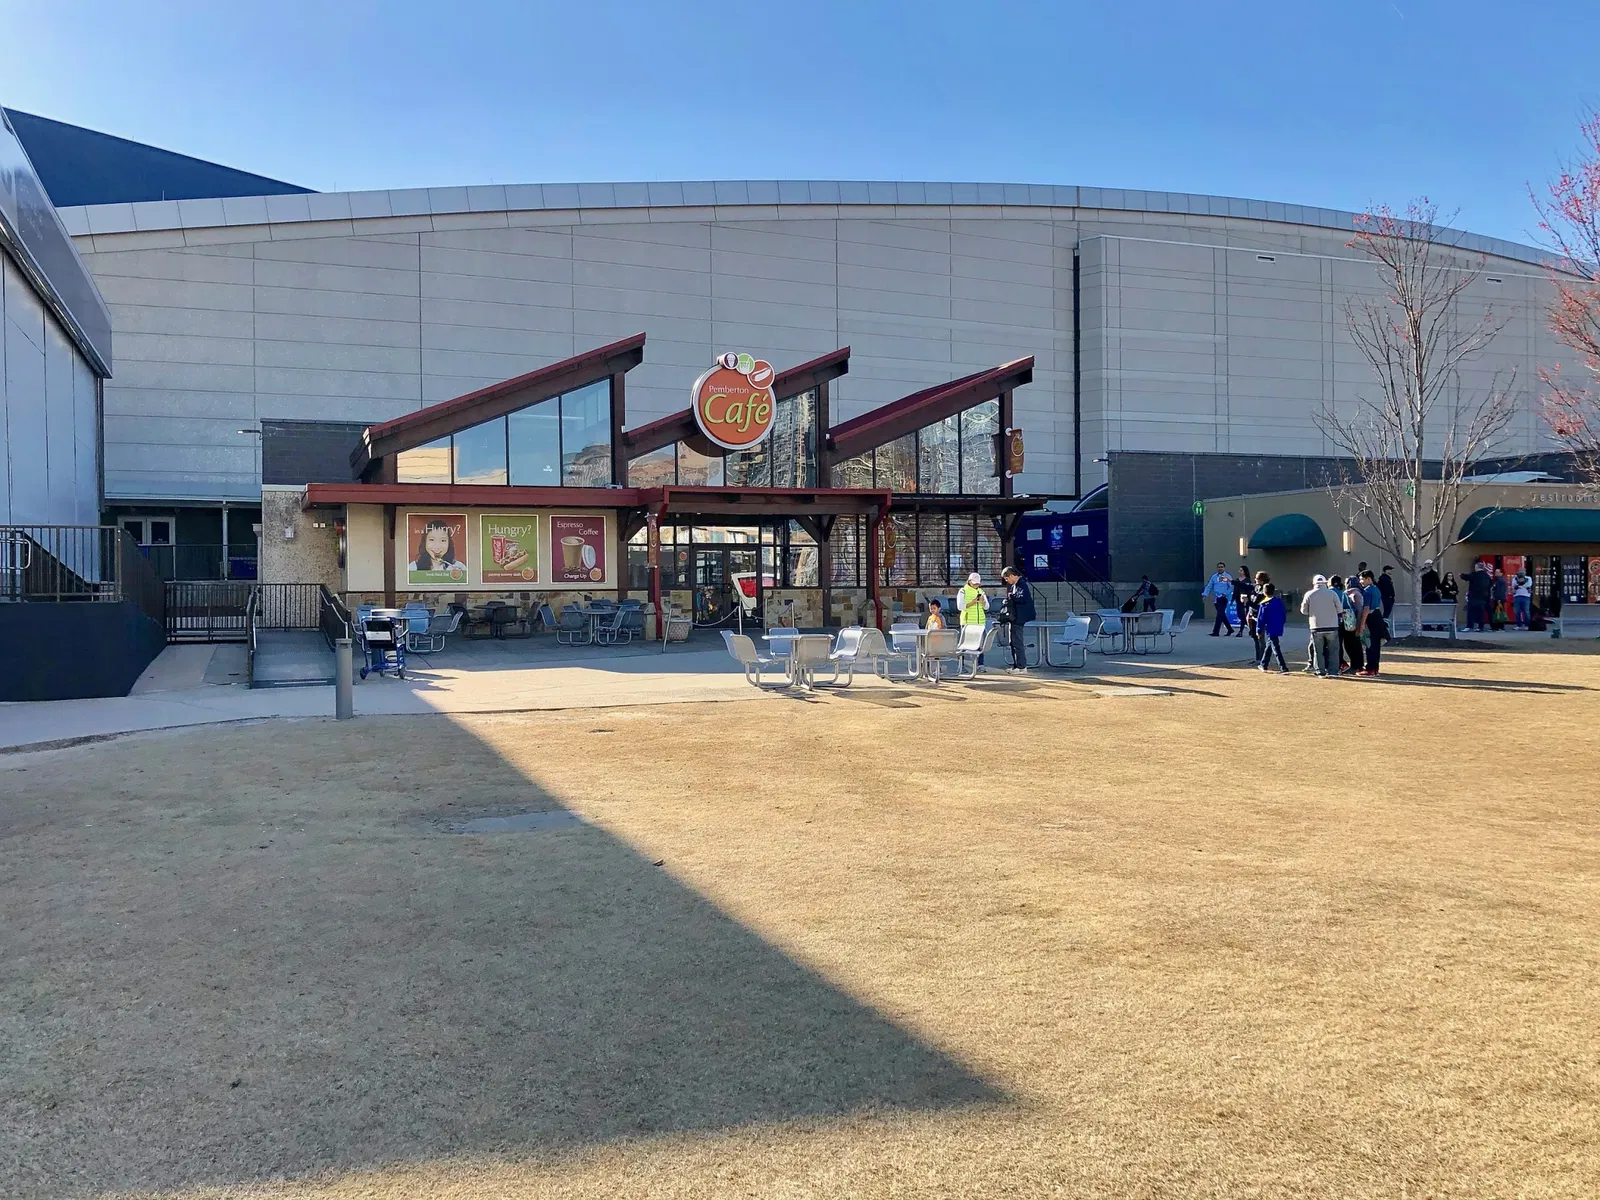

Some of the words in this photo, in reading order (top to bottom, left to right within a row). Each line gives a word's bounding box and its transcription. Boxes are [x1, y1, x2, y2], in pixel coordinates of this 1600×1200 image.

[708, 385, 750, 394] Pemberton
[704, 392, 770, 433] Café
[425, 524, 461, 537] Hurry?
[488, 524, 532, 537] Hungry?
[557, 521, 584, 529] Espresso
